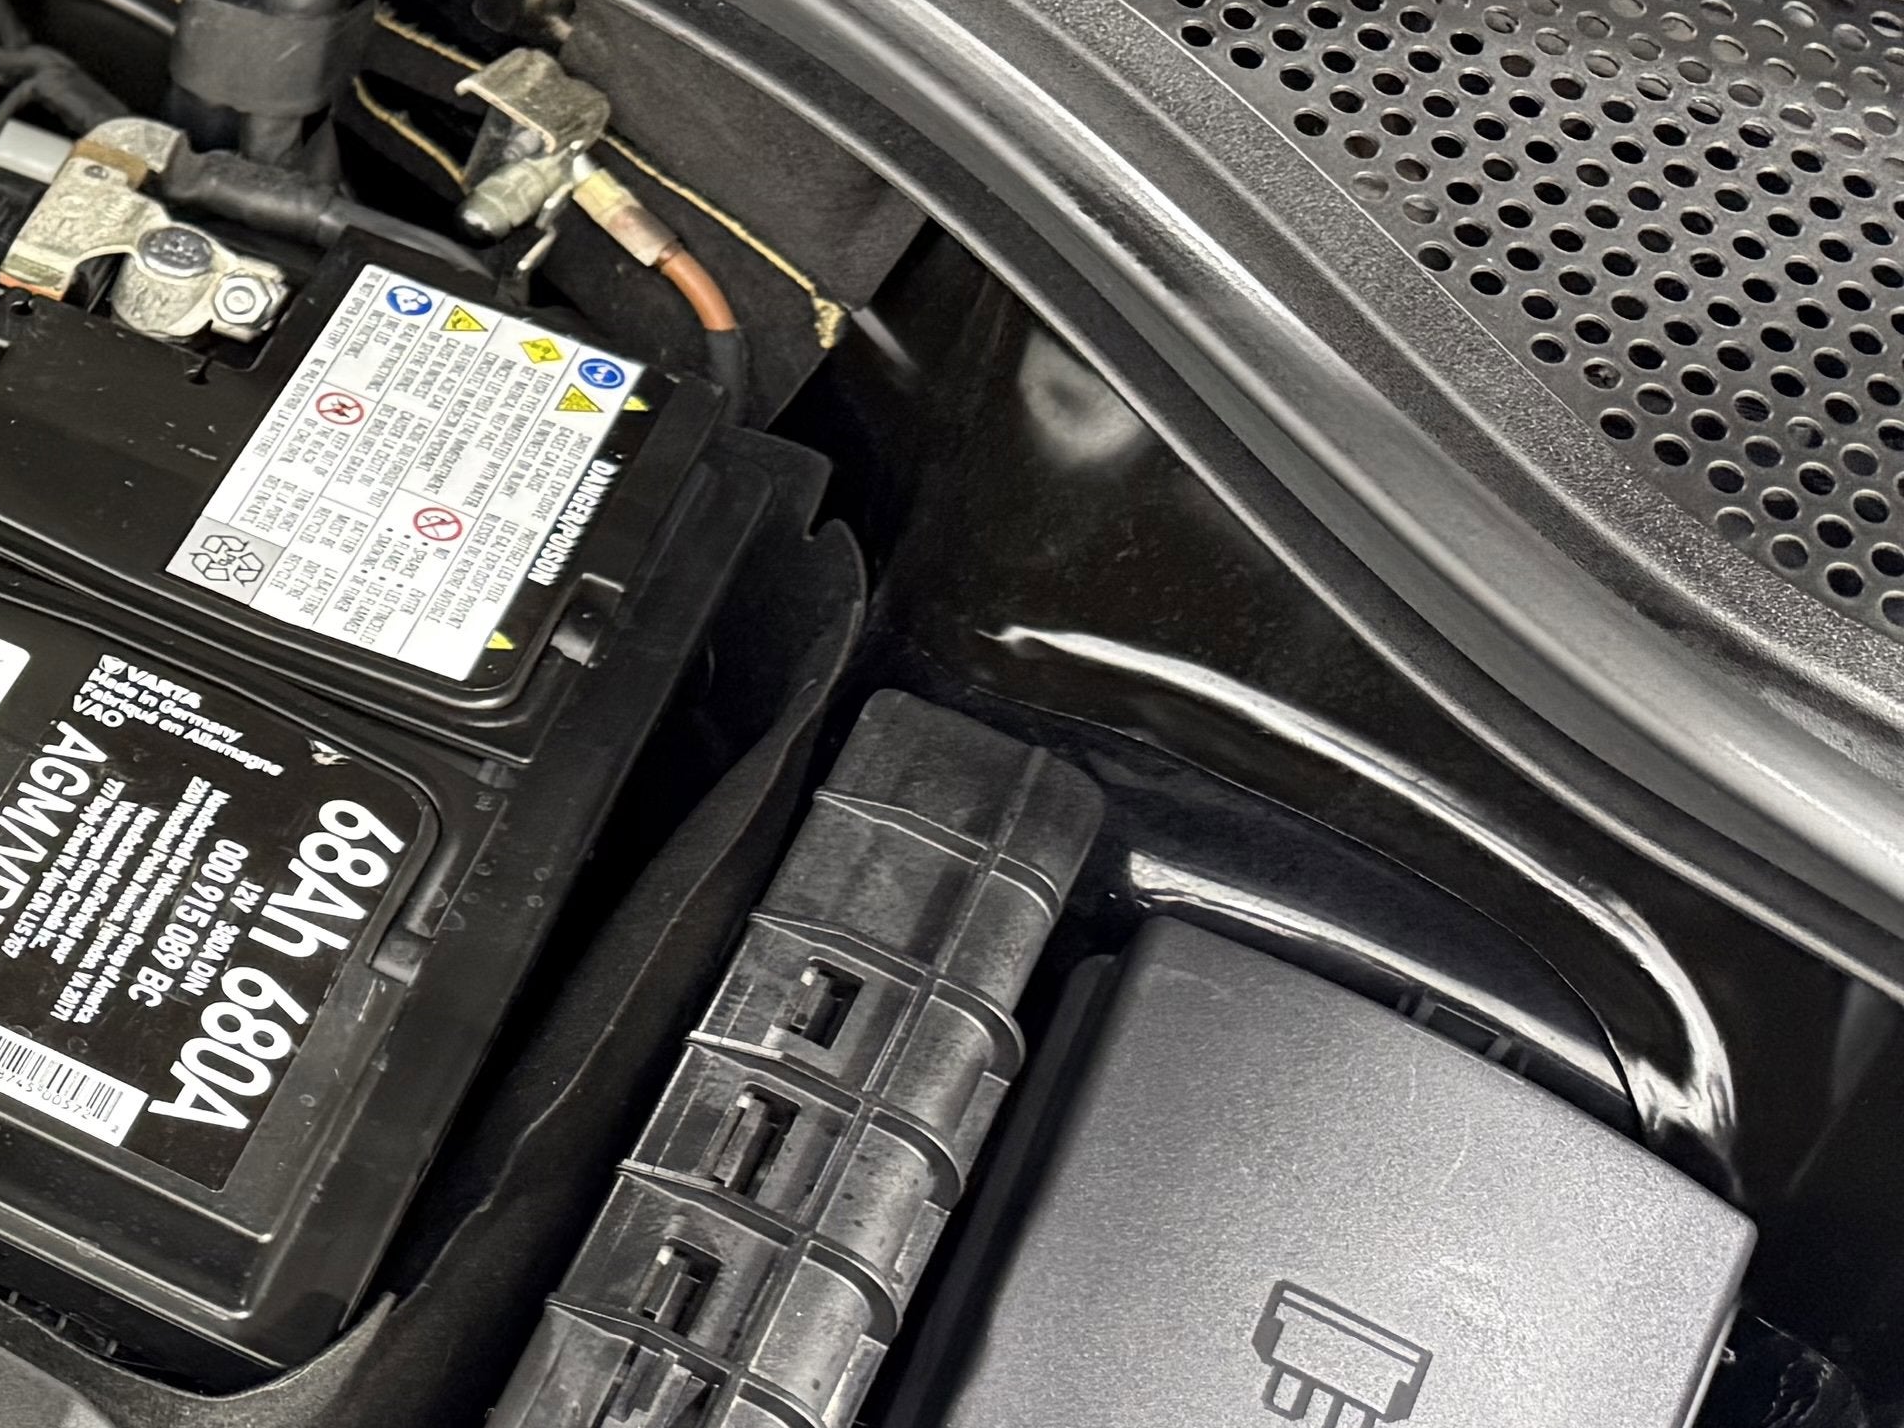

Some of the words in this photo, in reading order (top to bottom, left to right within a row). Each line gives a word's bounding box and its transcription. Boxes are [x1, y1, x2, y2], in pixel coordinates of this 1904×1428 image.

[527, 459, 616, 586] DANGER/POISON
[87, 666, 139, 700] Made
[137, 688, 159, 708] in
[157, 697, 243, 746] Germany
[123, 664, 203, 710] VARTA
[69, 693, 126, 730] VAO
[78, 679, 160, 728] Fabriqué
[158, 716, 184, 736] en
[182, 725, 284, 782] Allemagne
[77, 792, 113, 828] Bayly
[97, 775, 125, 801] 777
[180, 775, 212, 806] 2200
[61, 821, 96, 858] Street
[81, 794, 138, 863] Volkswagen
[102, 805, 160, 879] Manufactured
[151, 799, 197, 854] Woodland
[174, 787, 232, 861] Manufactured
[33, 864, 68, 896] Ajax
[61, 854, 101, 895] Group
[131, 847, 168, 887] Pointe
[164, 854, 191, 877] for
[198, 835, 251, 887] 000
[248, 799, 406, 959] 68Ah
[40, 887, 81, 933] Canada
[60, 871, 118, 942] for/Fabriqué
[124, 867, 182, 937] Volkswagen
[172, 876, 226, 929] 915
[227, 877, 265, 914] 12V
[27, 926, 57, 954] Inc.
[44, 933, 76, 965] pour
[104, 929, 145, 970] Group
[146, 920, 200, 973] 089
[196, 917, 241, 965] 380A
[67, 968, 93, 991] VA
[100, 963, 124, 983] of
[124, 964, 174, 1010] BC
[178, 958, 218, 997] DIN
[48, 984, 84, 1022] 20171
[149, 967, 309, 1129] 680A
